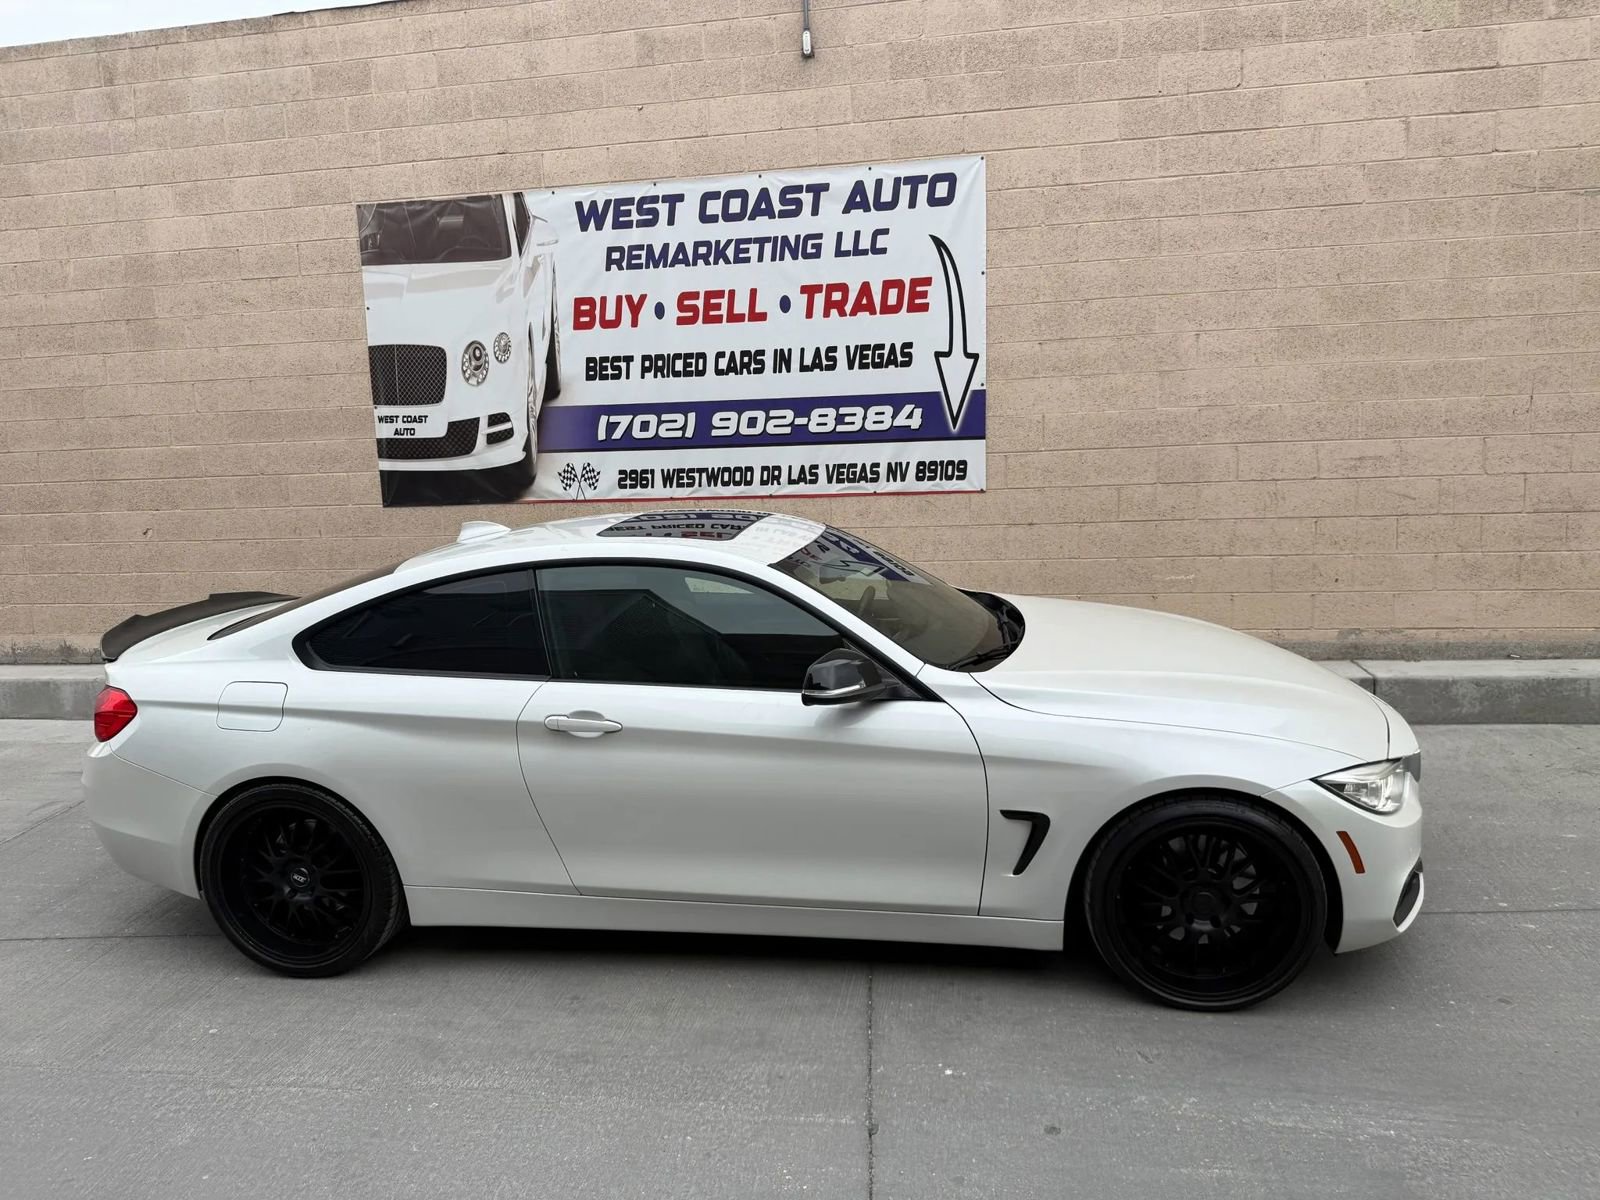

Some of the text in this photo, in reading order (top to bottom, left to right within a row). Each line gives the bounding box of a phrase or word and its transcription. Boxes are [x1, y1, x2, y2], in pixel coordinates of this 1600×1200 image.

[574, 172, 958, 233] WEST COAST AUTO
[605, 227, 890, 272] REMARKETING LLC
[572, 276, 933, 331] BUY SELL TRADE
[585, 341, 914, 382] BEST PRICED CARS IN LAS VEGAS
[377, 414, 429, 424] WEST COAST
[393, 427, 416, 437] AUTO
[597, 404, 923, 441] (702) 902-8384
[617, 459, 968, 490] 2961 WESTWOOD DR LAS VEGAS NV 89109
